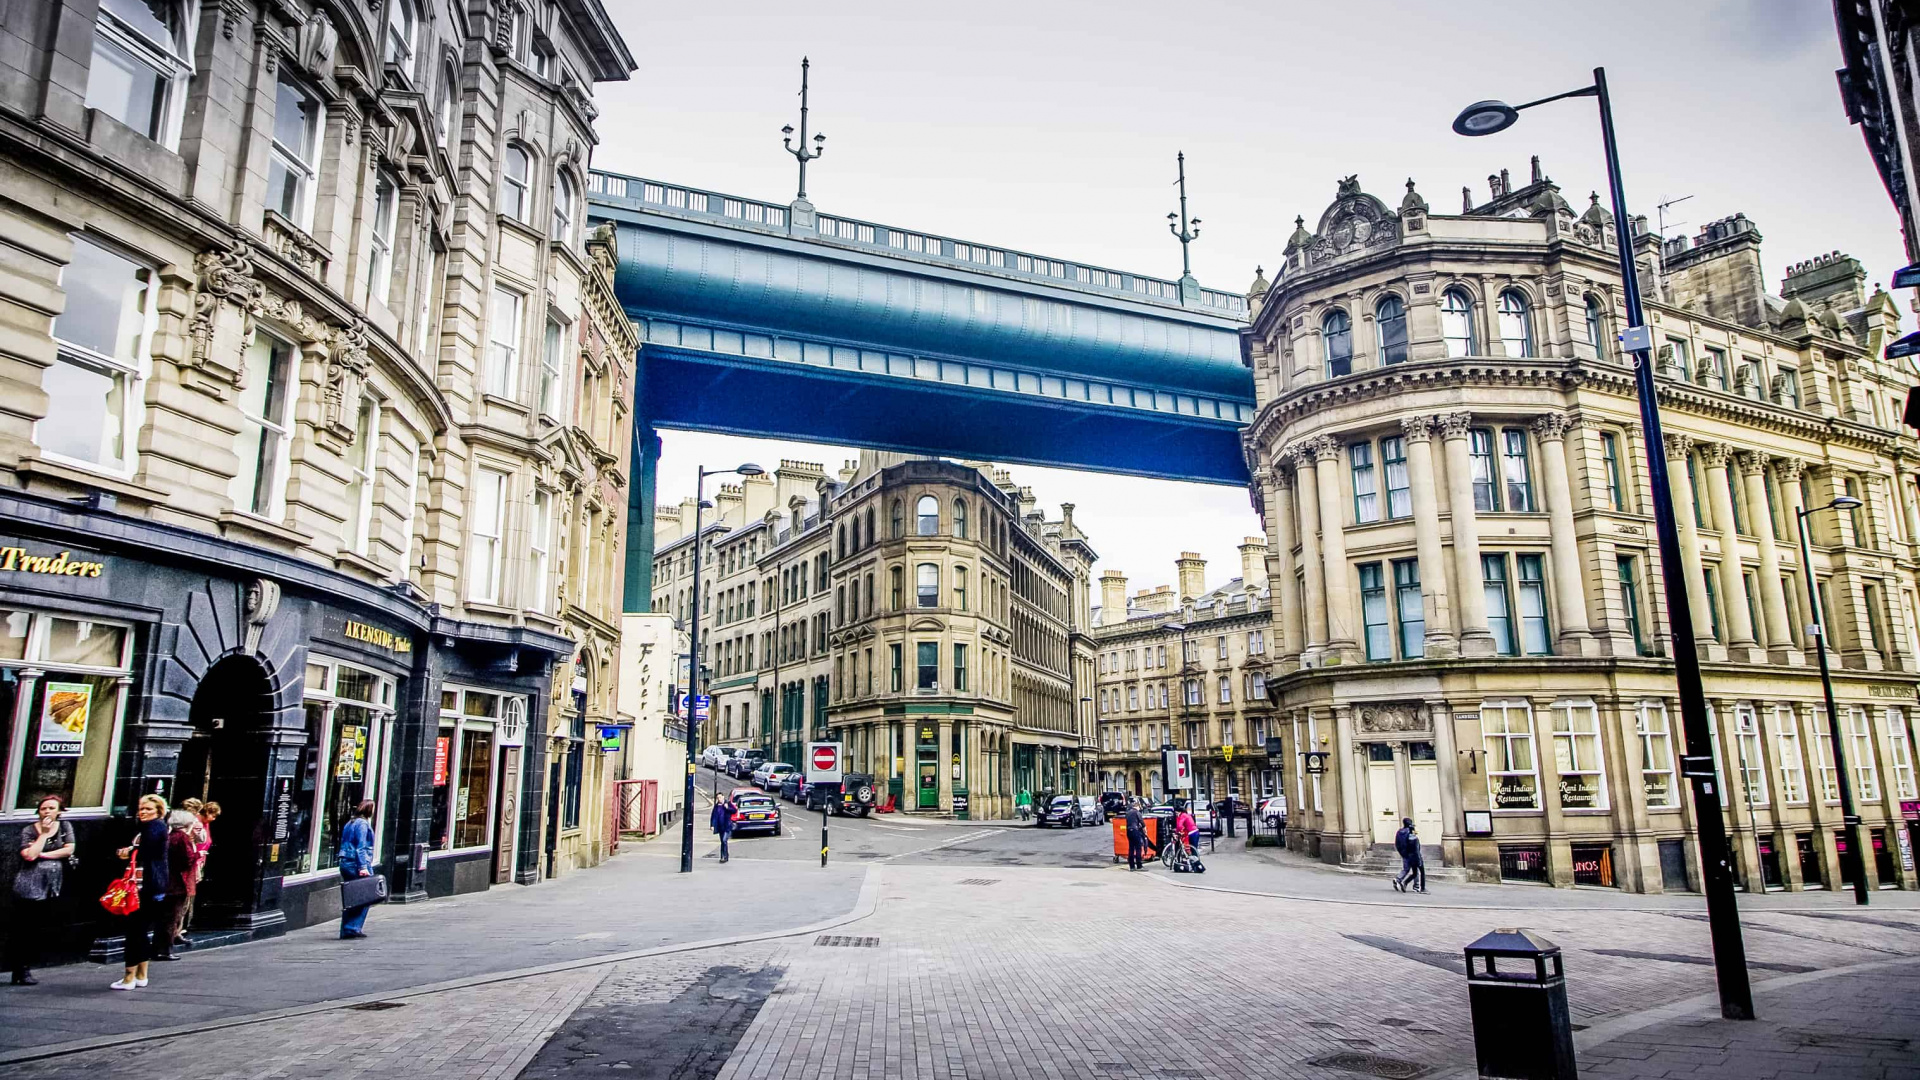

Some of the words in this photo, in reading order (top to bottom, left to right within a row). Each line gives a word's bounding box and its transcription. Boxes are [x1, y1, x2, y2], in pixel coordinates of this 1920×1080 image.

[0, 547, 104, 578] Traders
[344, 620, 393, 649] AKENSIDE
[41, 743, 61, 752] ONLY
[1493, 782, 1512, 795] Rani
[1513, 785, 1534, 793] Indian
[1558, 781, 1577, 794] Rani
[1497, 795, 1532, 803] Restaurant
[1562, 794, 1598, 802] Restaurant
